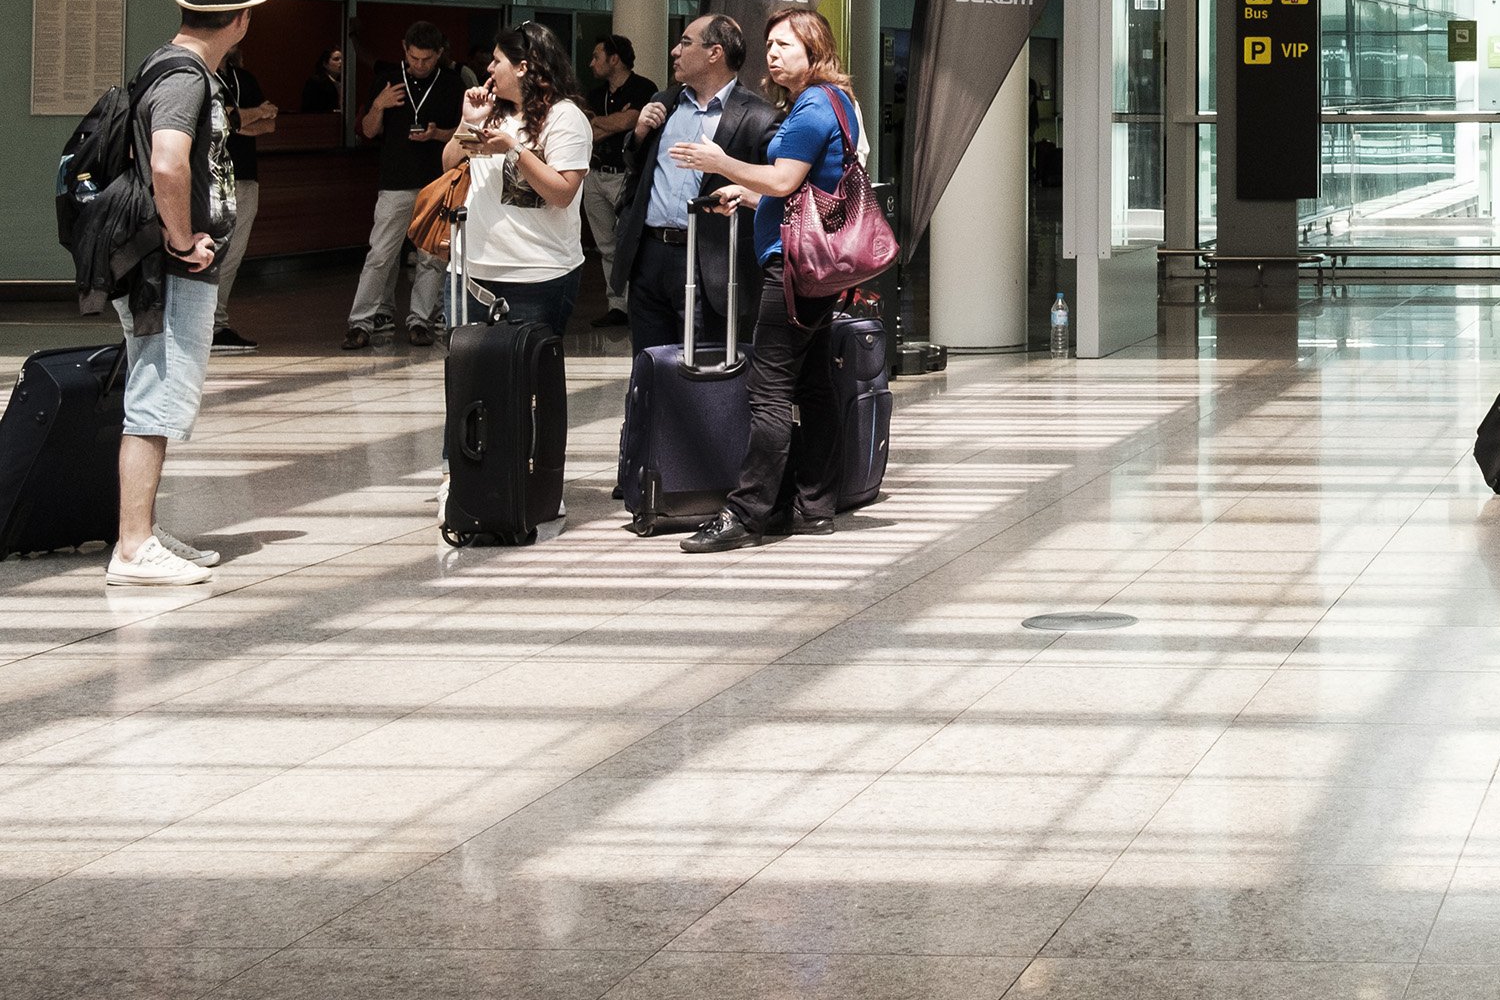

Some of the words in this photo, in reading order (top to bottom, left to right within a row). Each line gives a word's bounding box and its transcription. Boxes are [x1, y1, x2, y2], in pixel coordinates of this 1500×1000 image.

[1244, 7, 1268, 19] Bus
[1251, 41, 1266, 61] P
[1281, 43, 1309, 58] VIP
